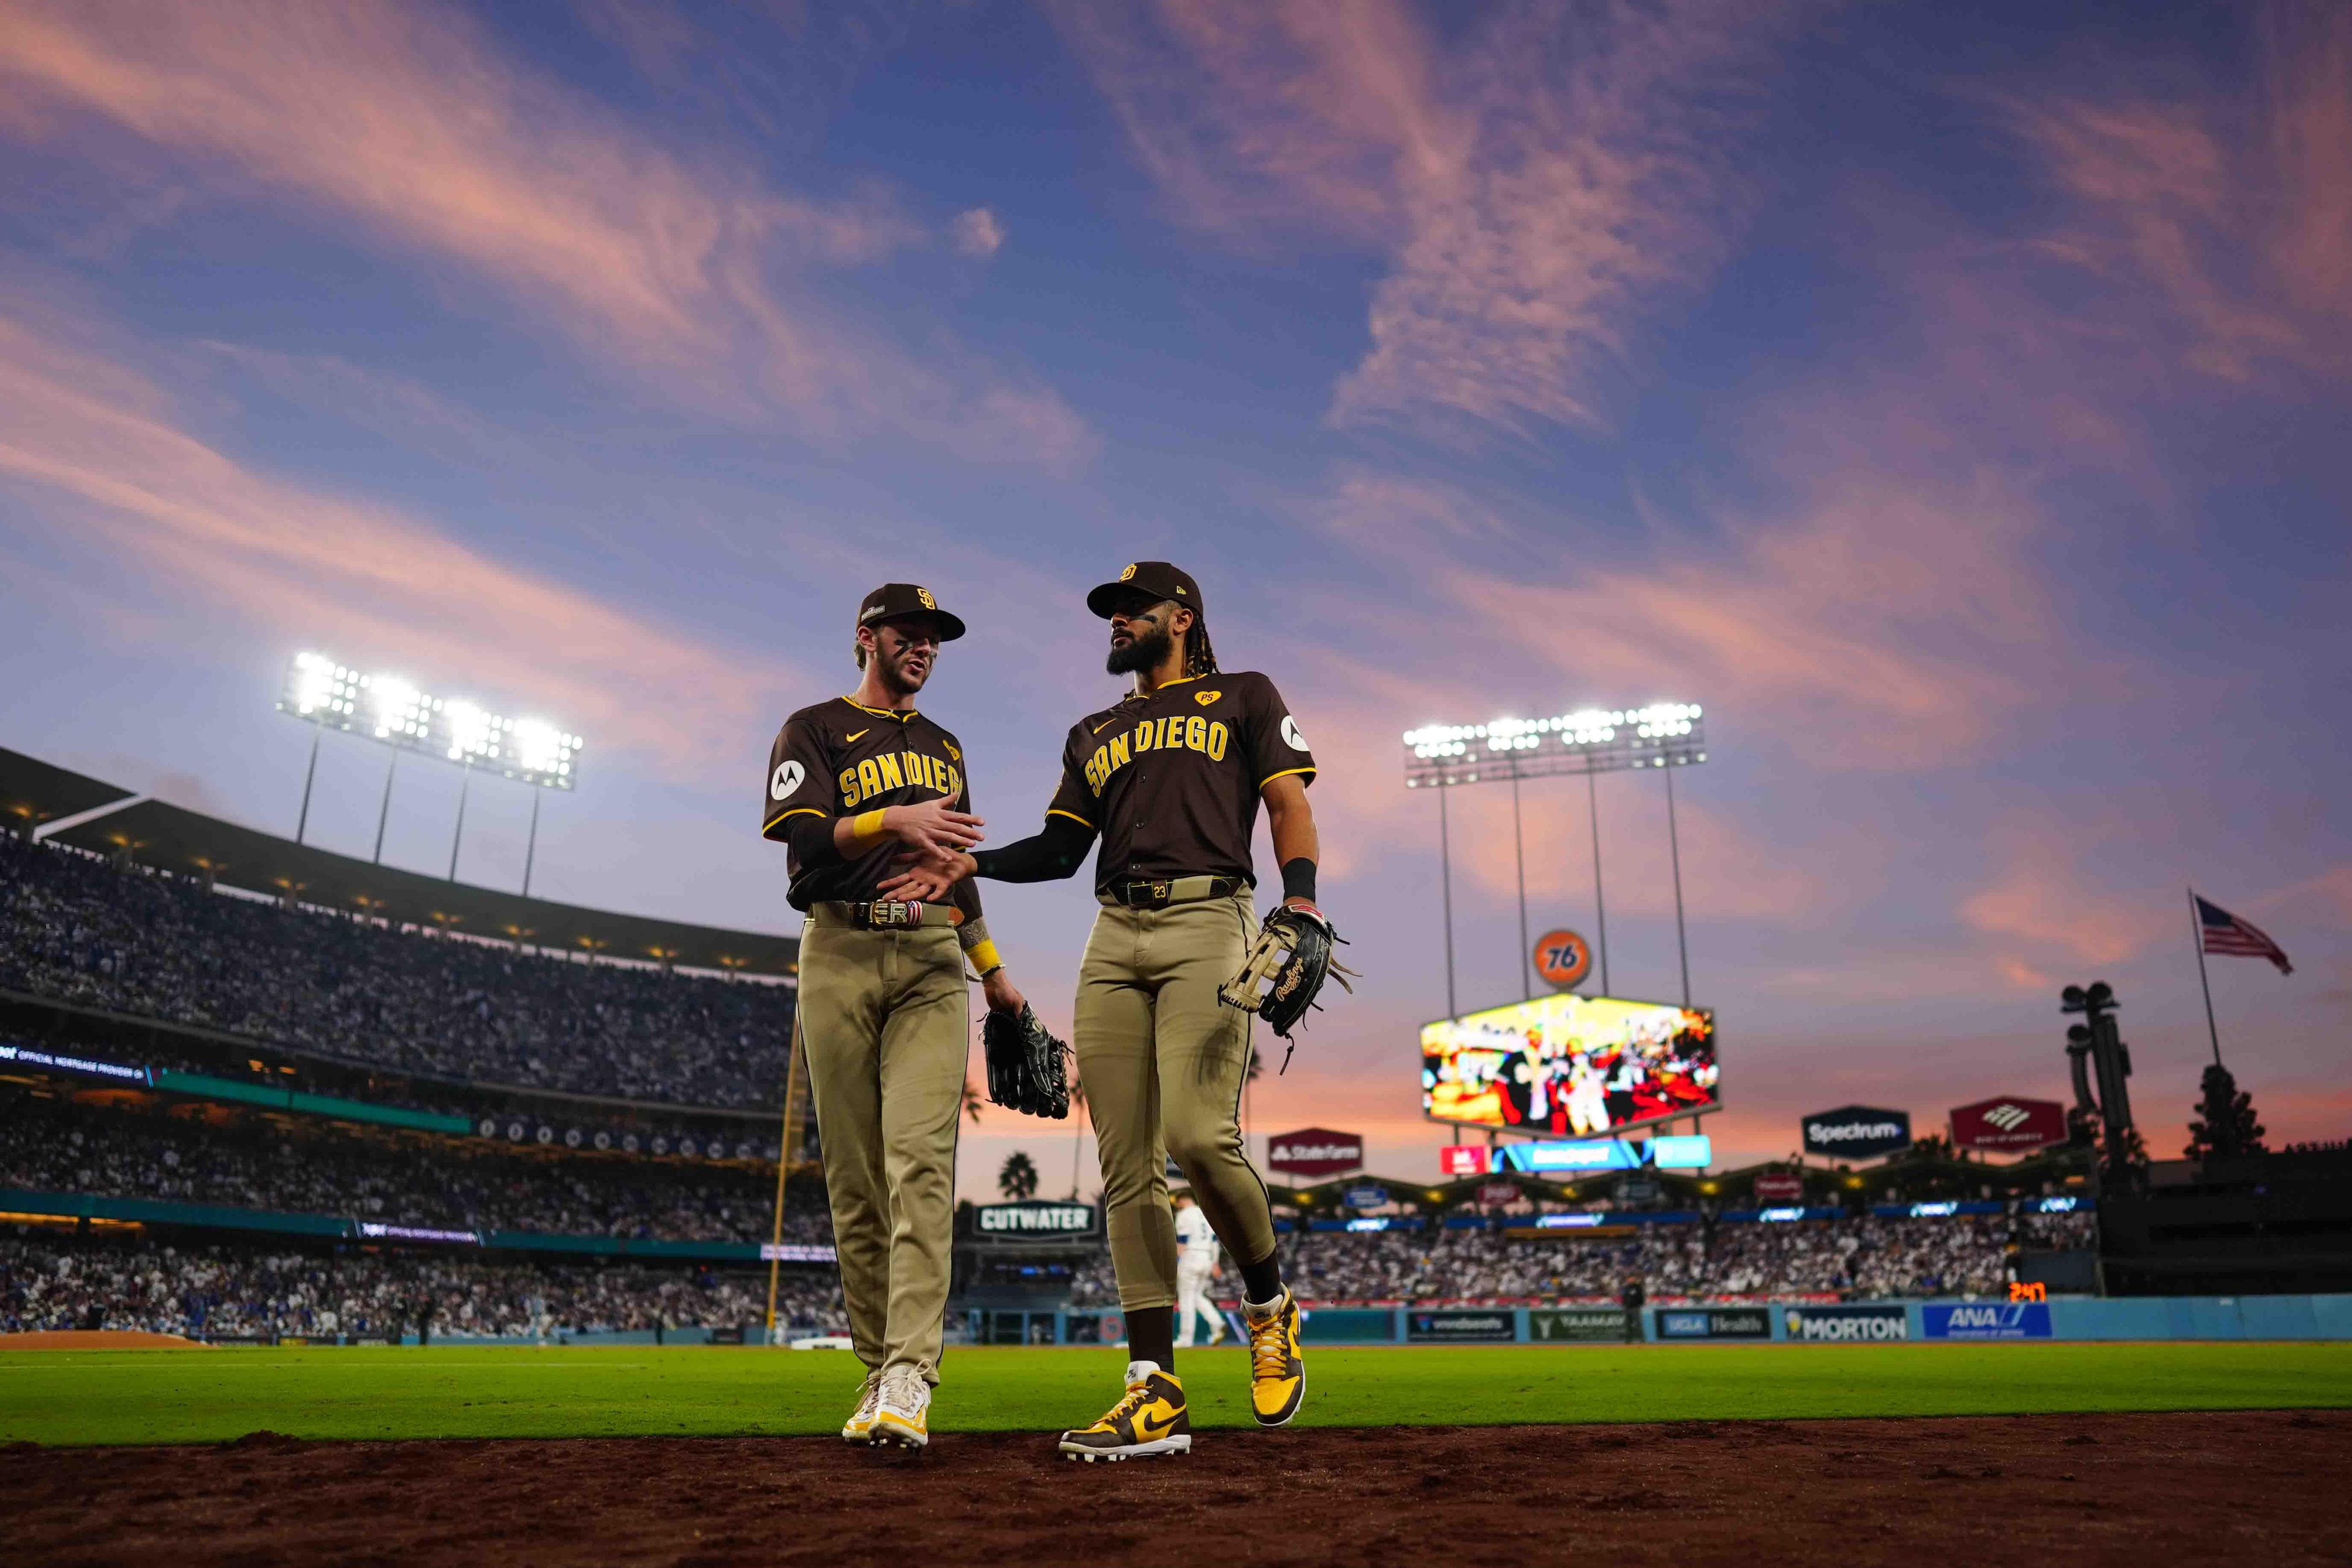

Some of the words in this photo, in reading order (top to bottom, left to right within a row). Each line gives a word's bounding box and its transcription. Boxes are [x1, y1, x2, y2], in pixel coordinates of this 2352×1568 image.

[1085, 731, 1131, 797] SAN
[1135, 715, 1229, 761] DIEGO
[839, 753, 905, 807] SAN
[901, 750, 963, 805] DIEG
[1154, 886, 1166, 899] 23
[1547, 943, 1578, 970] 76
[1276, 957, 1304, 1001] Rawlings
[18, 1050, 54, 1065] OFFICIAL
[1809, 1122, 1896, 1145] Spectrum
[981, 1208, 1088, 1230] CUTWATER
[1669, 1319, 1704, 1332] UCLA
[1711, 1315, 1763, 1333] Health
[1803, 1317, 1906, 1340] MORTON
[1948, 1307, 1997, 1327] ANA
